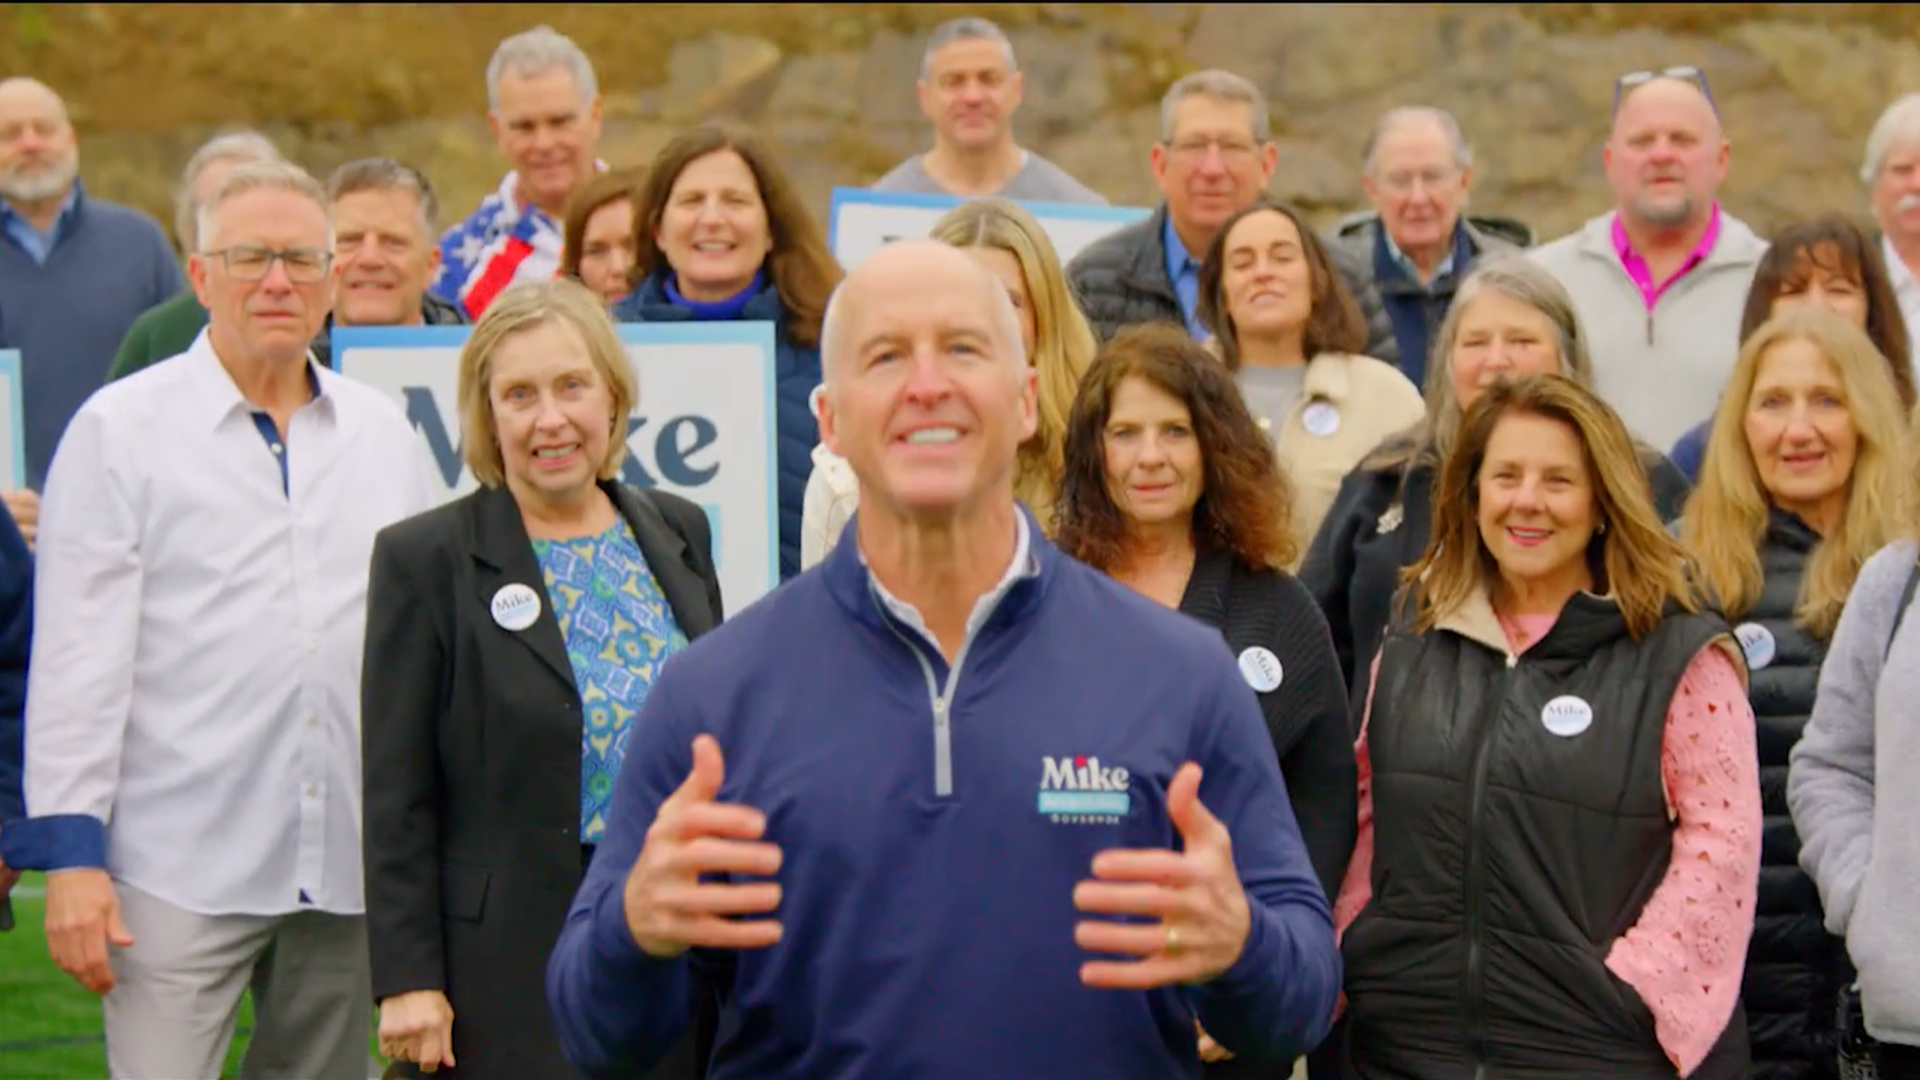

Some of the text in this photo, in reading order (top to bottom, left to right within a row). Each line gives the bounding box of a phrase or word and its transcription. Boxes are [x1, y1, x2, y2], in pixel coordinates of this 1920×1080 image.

[402, 386, 719, 487] ke
[495, 593, 533, 614] Mike
[1548, 704, 1588, 716] Mike
[1040, 754, 1130, 791] Mike
